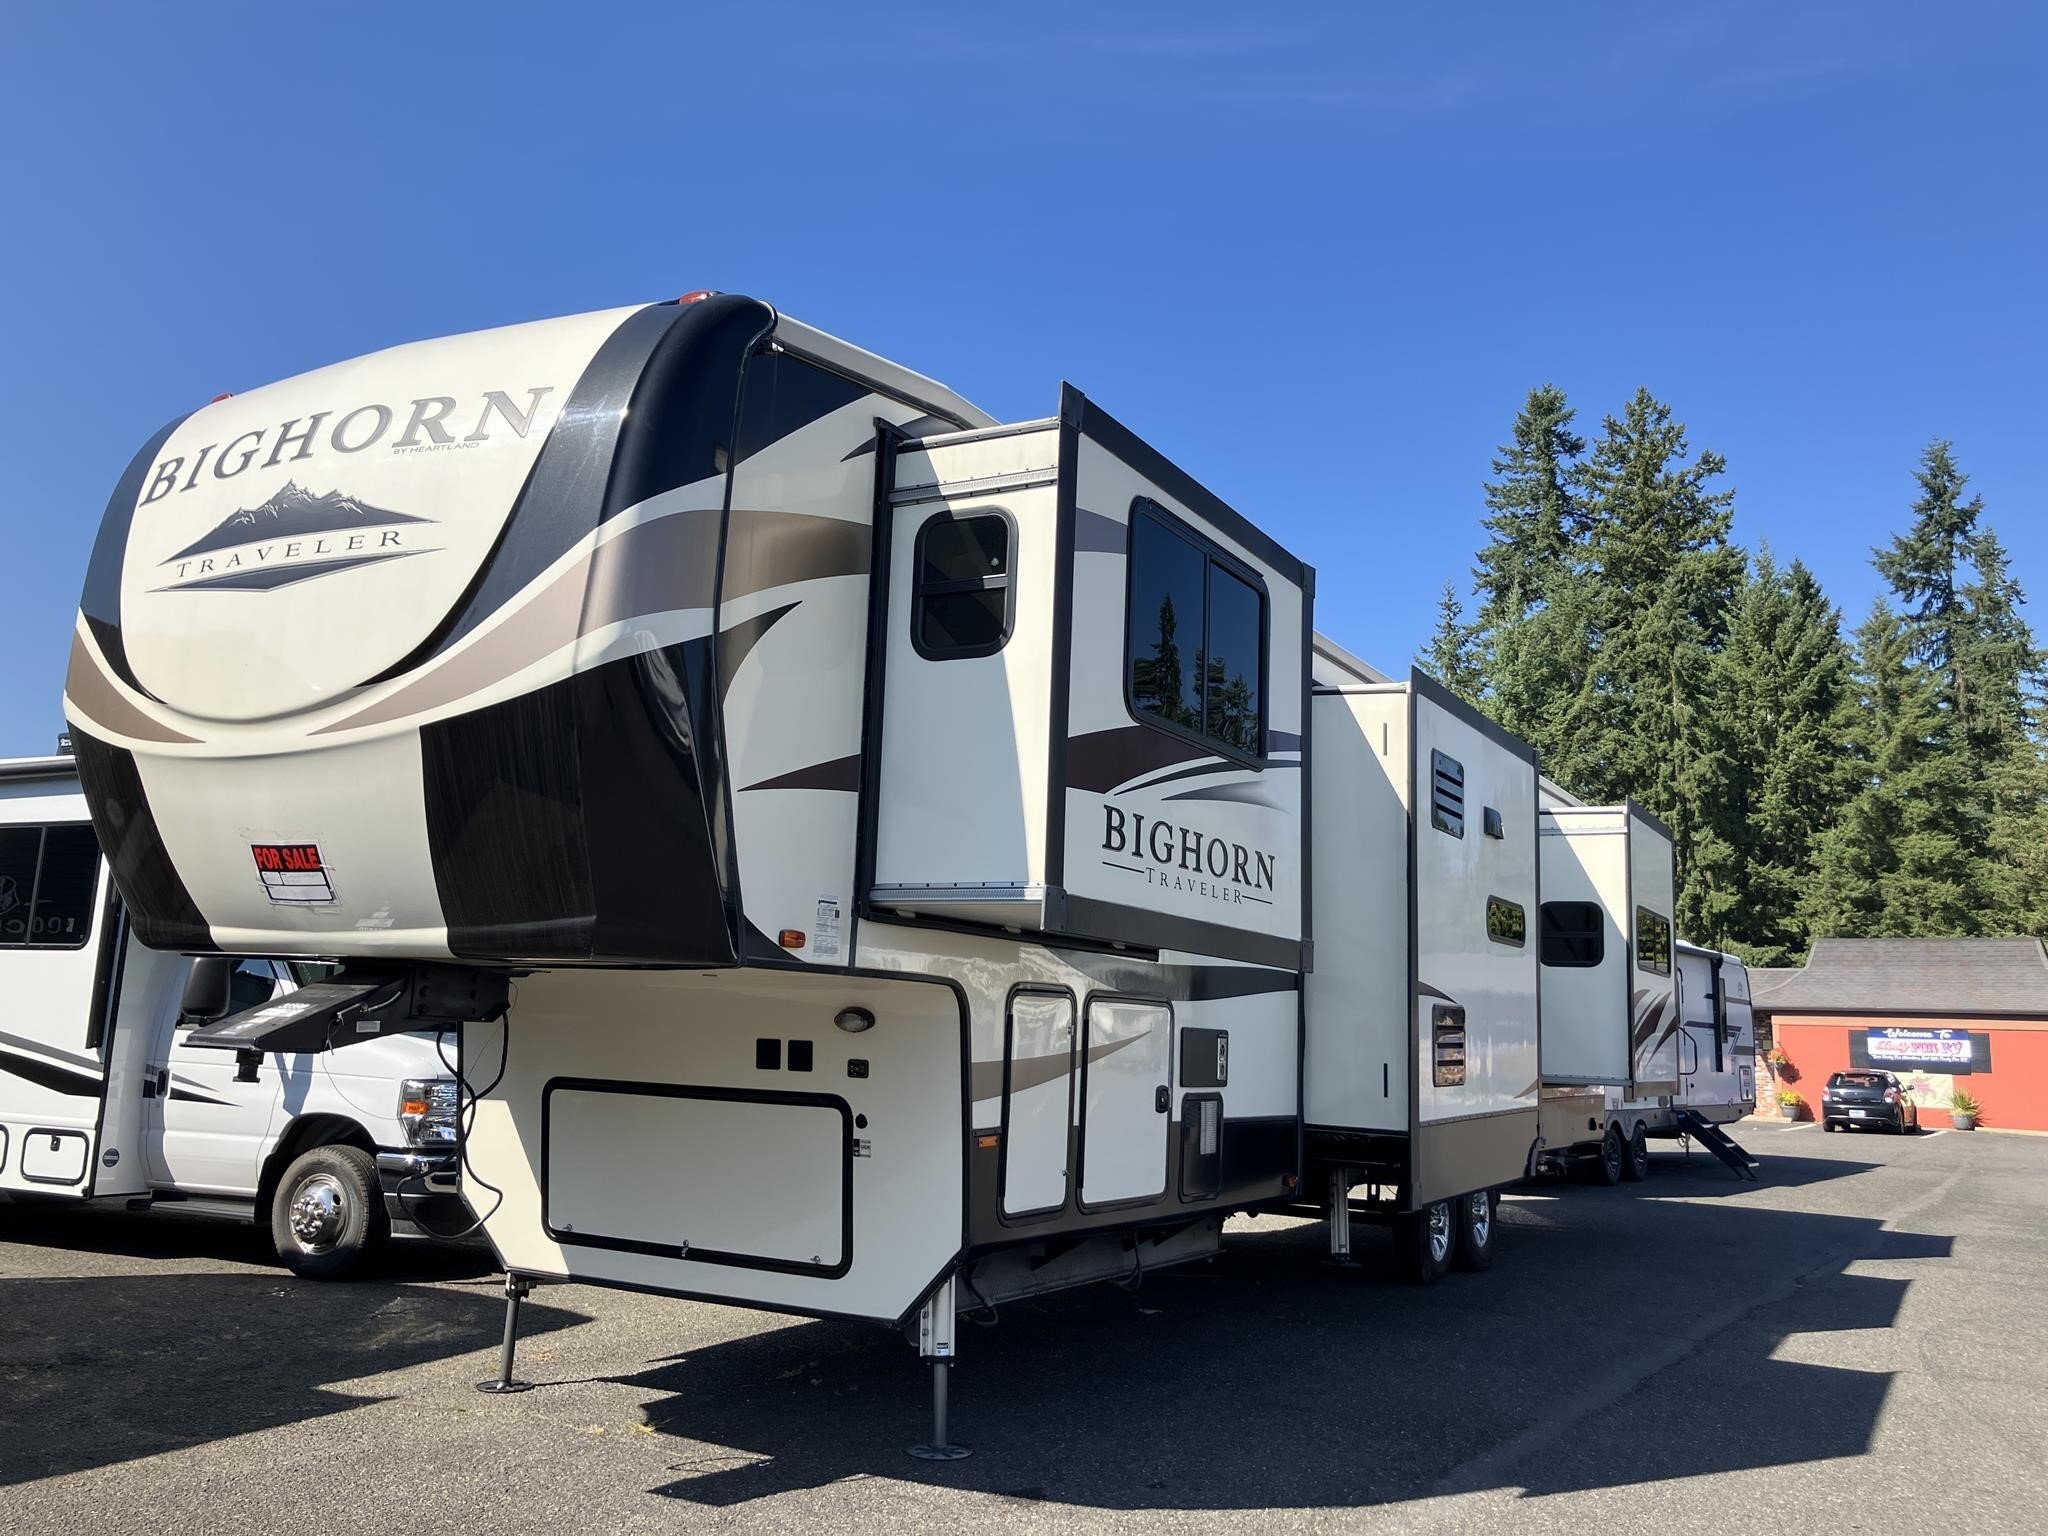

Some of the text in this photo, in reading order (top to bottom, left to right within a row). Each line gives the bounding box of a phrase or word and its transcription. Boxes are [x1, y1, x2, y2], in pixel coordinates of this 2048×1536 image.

[139, 386, 555, 508] BIGHORN
[393, 441, 480, 455] BY HEARTLAND
[176, 530, 403, 578] TRAVELER
[253, 847, 322, 869] FOR SALE
[1102, 804, 1276, 892] BIGHORN
[1145, 866, 1243, 905] TRAVELER
[1882, 1028, 1953, 1040] Welcome To
